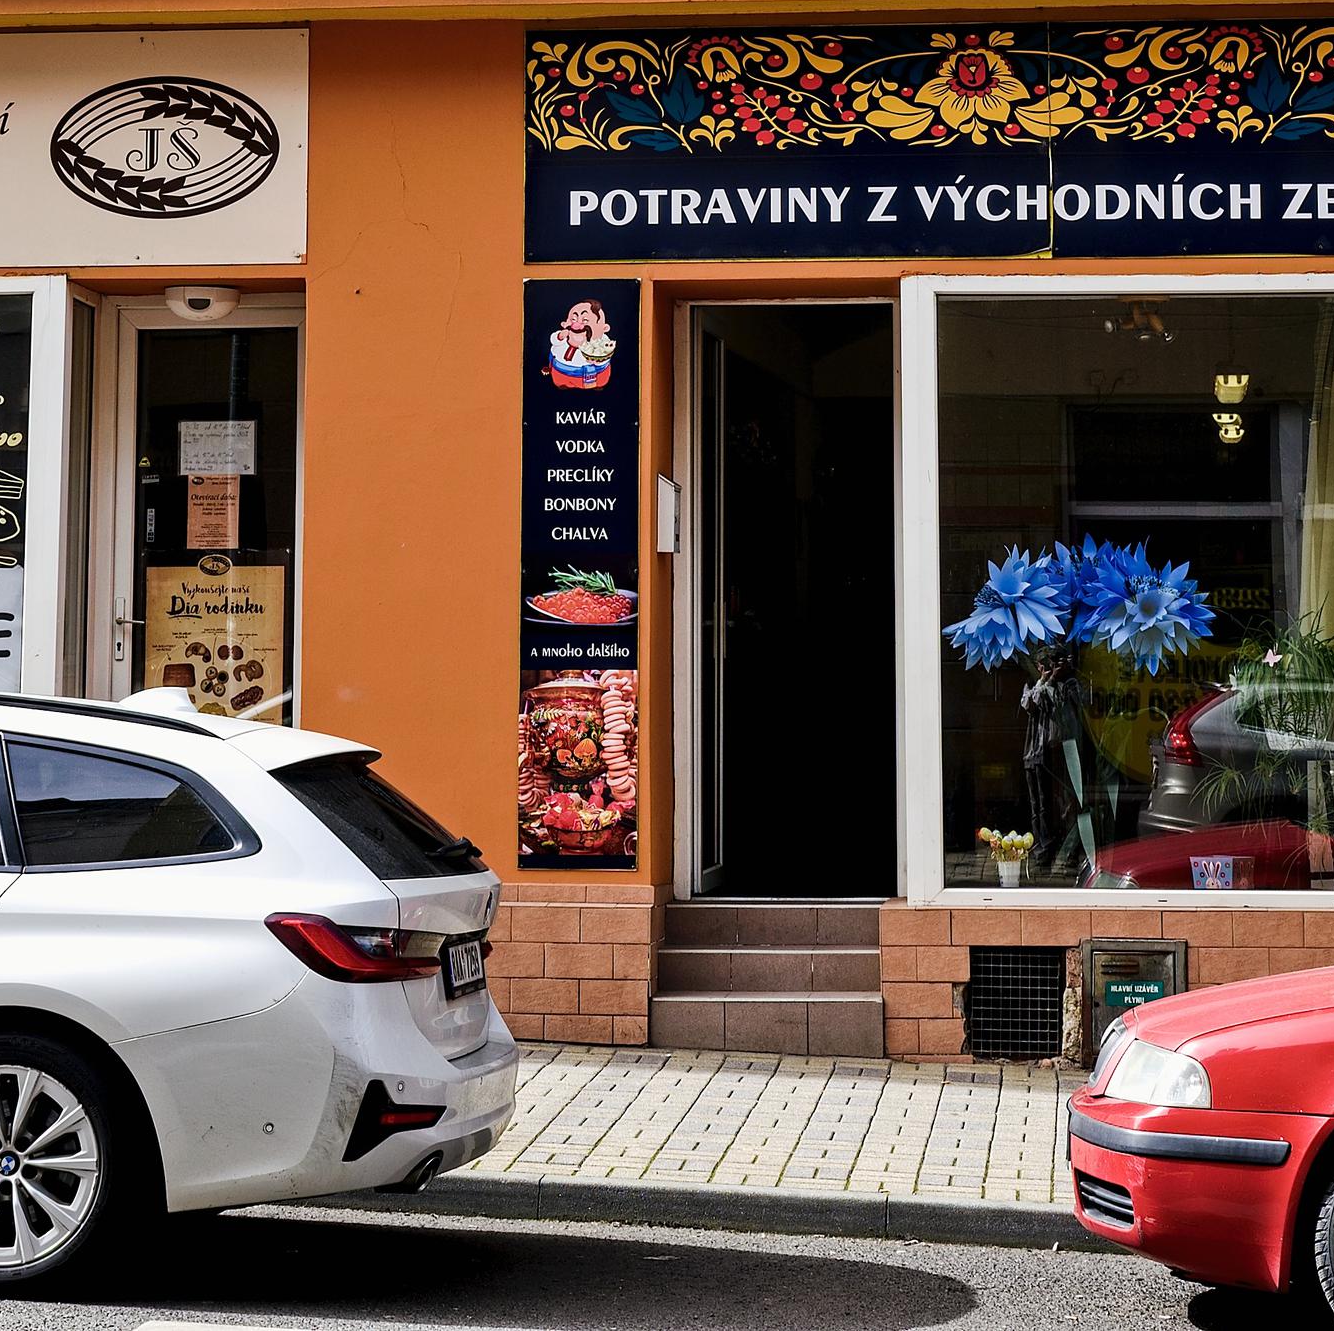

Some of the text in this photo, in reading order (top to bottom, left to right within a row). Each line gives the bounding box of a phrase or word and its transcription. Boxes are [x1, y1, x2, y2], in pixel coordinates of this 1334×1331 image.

[126, 118, 200, 173] JŠ
[569, 186, 851, 226] POTRAVINY
[866, 186, 898, 222] Z
[914, 174, 1262, 223] VÝCHODNÍCH
[556, 407, 606, 425] KAVIÁR
[555, 439, 605, 454] VODKA
[547, 465, 615, 483] PRECLÍKY
[544, 497, 617, 512] BONBONY
[551, 526, 609, 541] CHALVA
